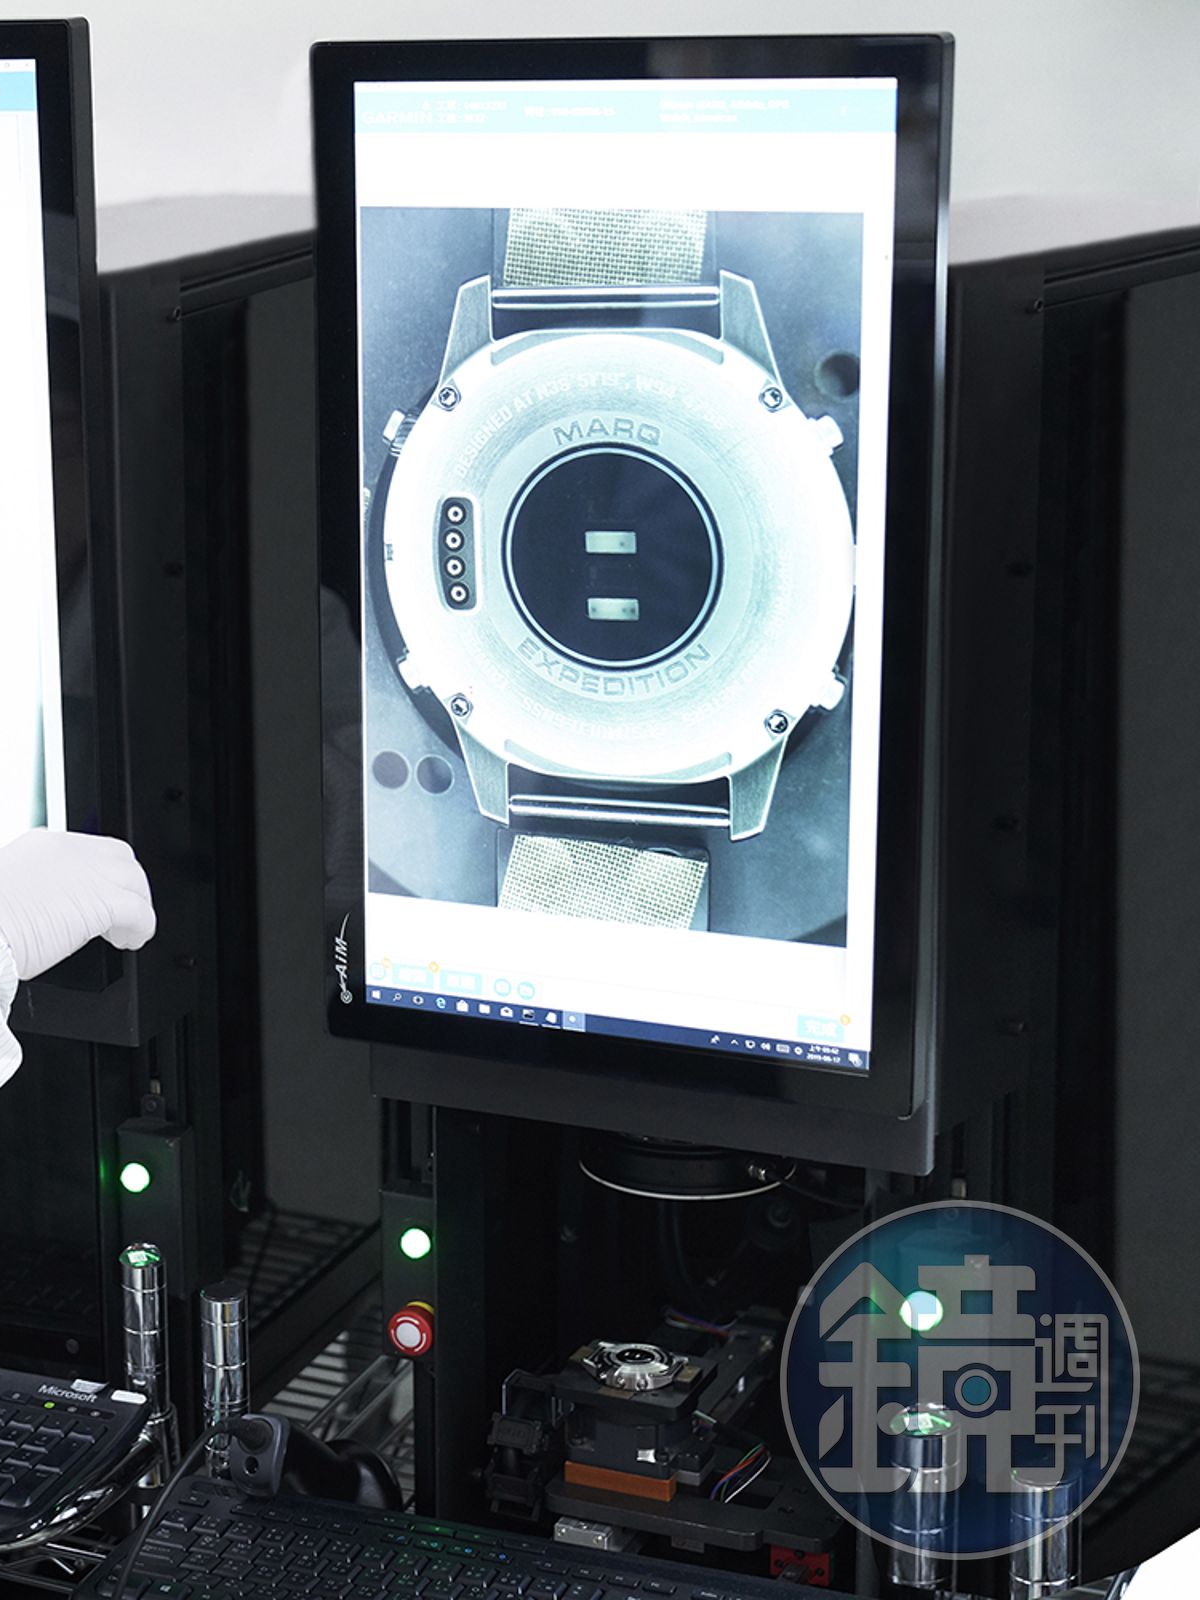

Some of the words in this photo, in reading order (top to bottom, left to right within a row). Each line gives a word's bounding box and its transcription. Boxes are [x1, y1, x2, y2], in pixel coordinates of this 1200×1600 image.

[453, 404, 513, 479] DESIGNED
[513, 390, 534, 413] AT
[552, 418, 661, 446] MARQ
[517, 637, 712, 696] EXPEDITION
[38, 1384, 98, 1403] Microsoft
